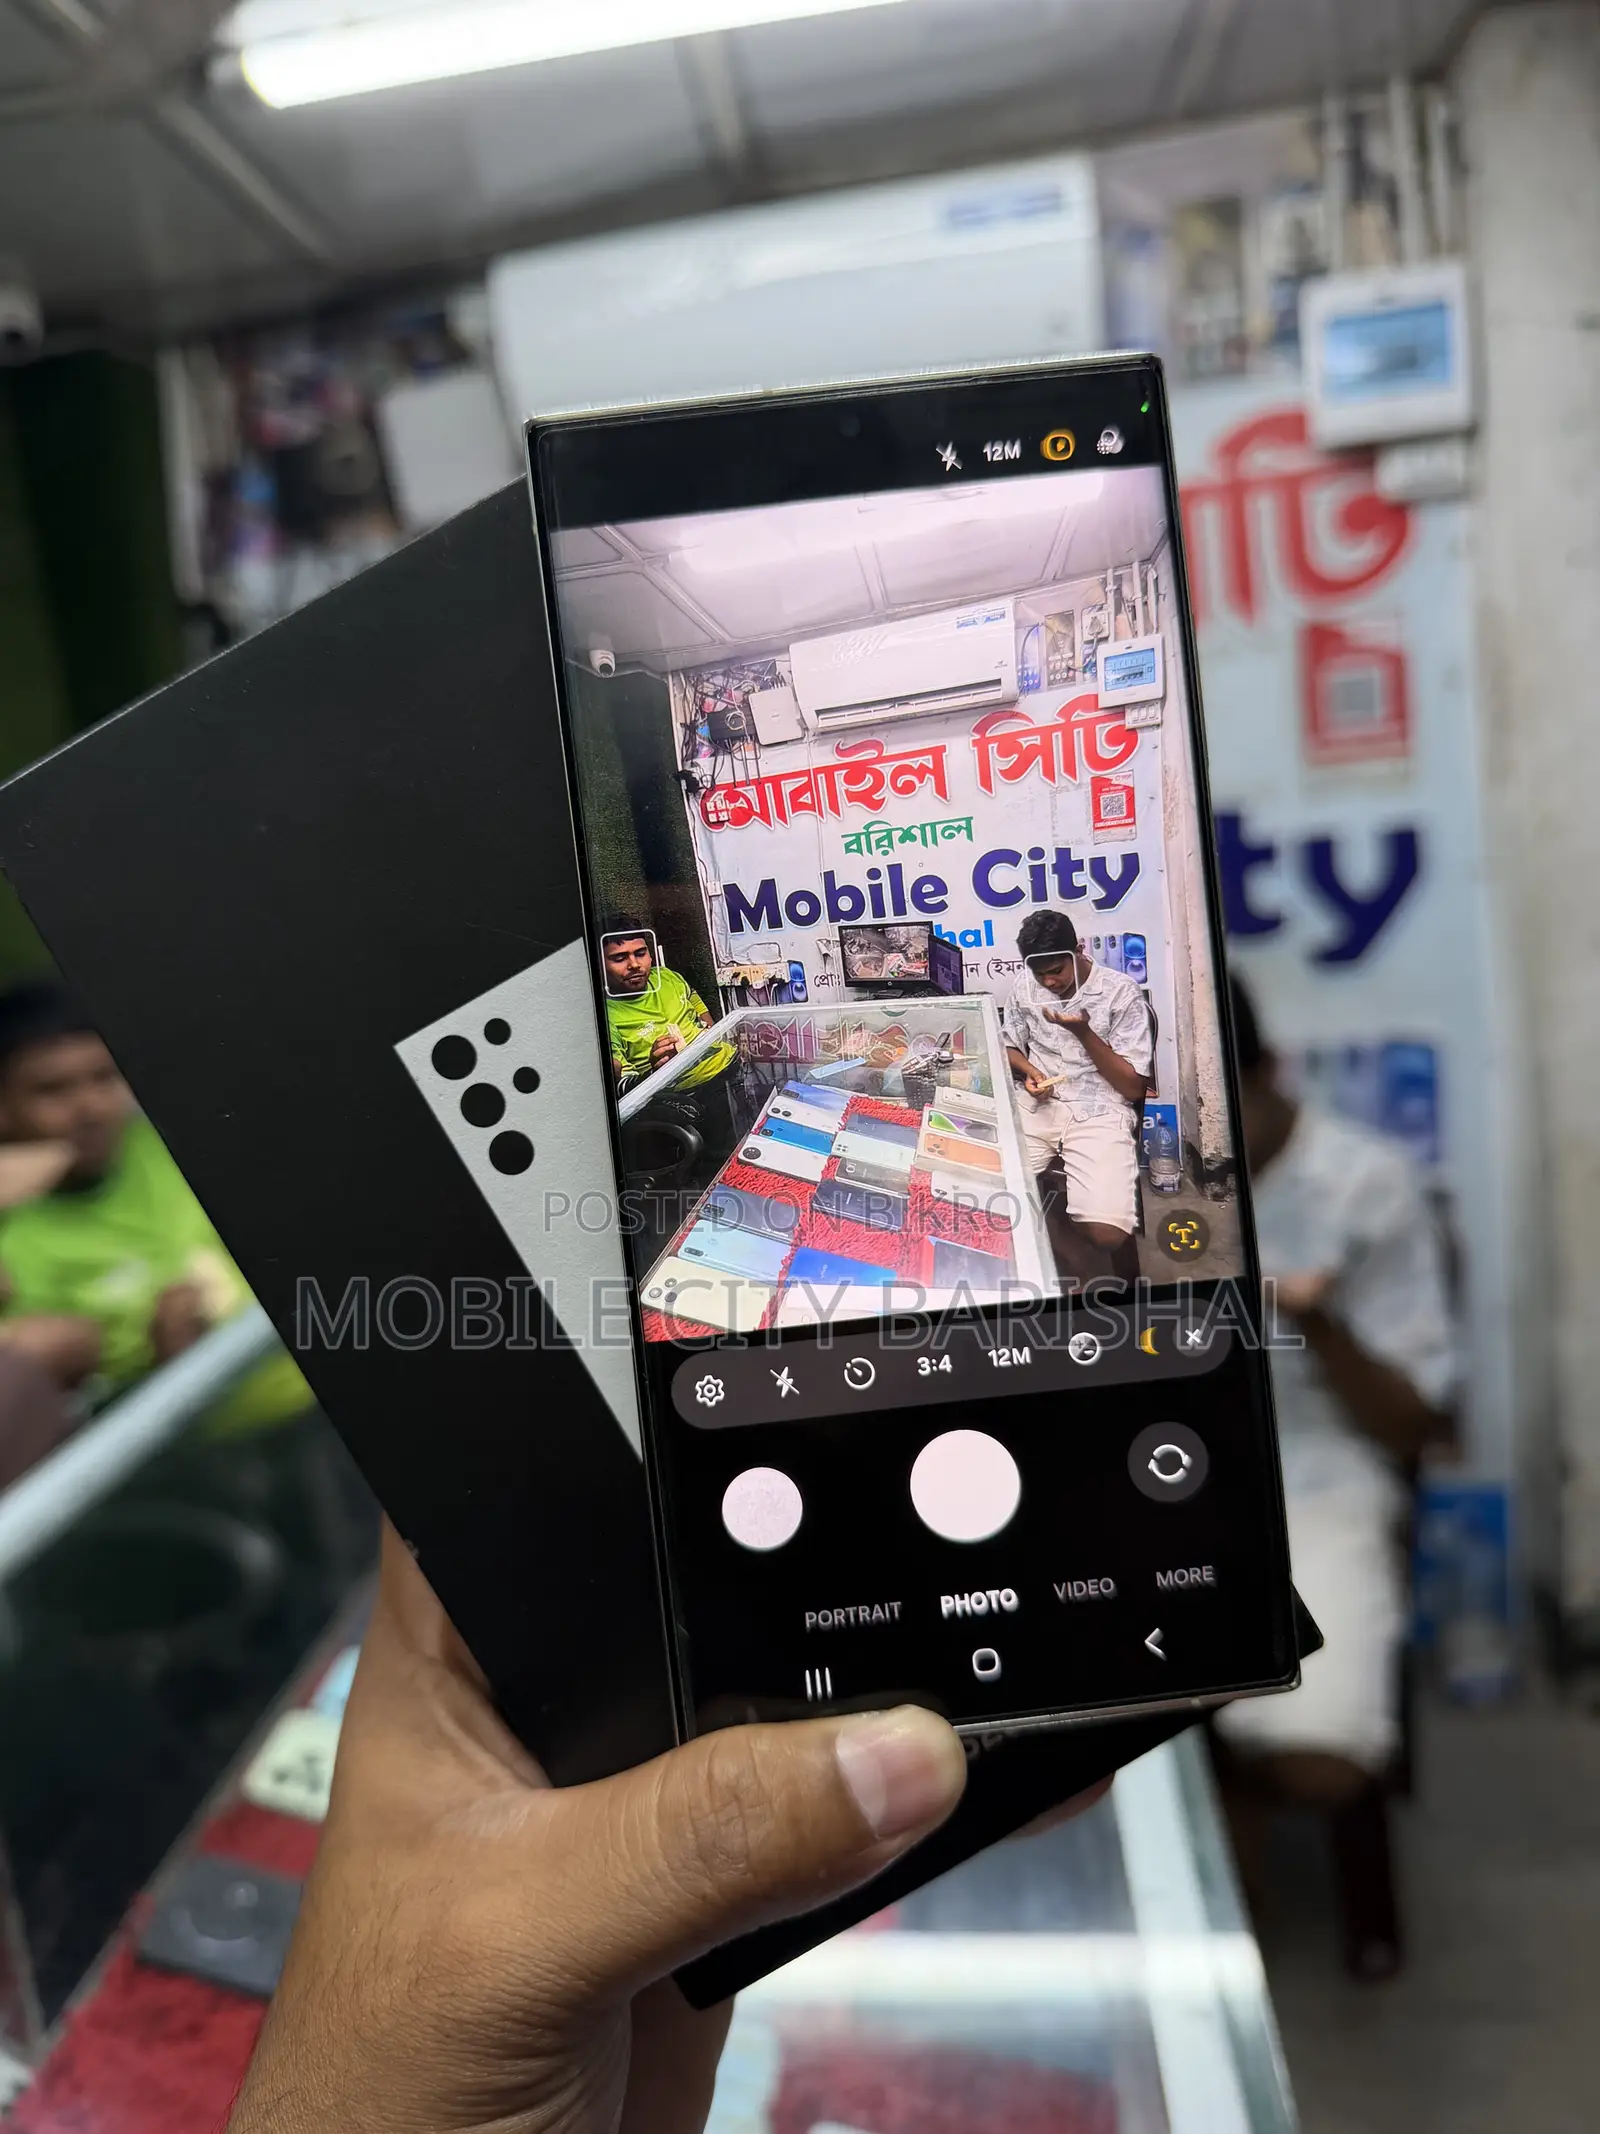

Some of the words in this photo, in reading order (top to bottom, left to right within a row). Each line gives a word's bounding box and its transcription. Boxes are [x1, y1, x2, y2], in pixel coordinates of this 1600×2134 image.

[983, 437, 1022, 462] 12M
[970, 693, 1140, 798] সিটি
[841, 817, 973, 857] বরিশাল
[722, 862, 949, 935] Mobile
[971, 846, 1141, 911] City
[916, 1354, 953, 1376] 3:4
[987, 1346, 1032, 1368] 12M
[804, 1600, 902, 1632] PORTRAIT
[940, 1587, 1020, 1619] PHOTO
[1053, 1577, 1117, 1603] VIDEO
[1156, 1564, 1217, 1591] MORE
